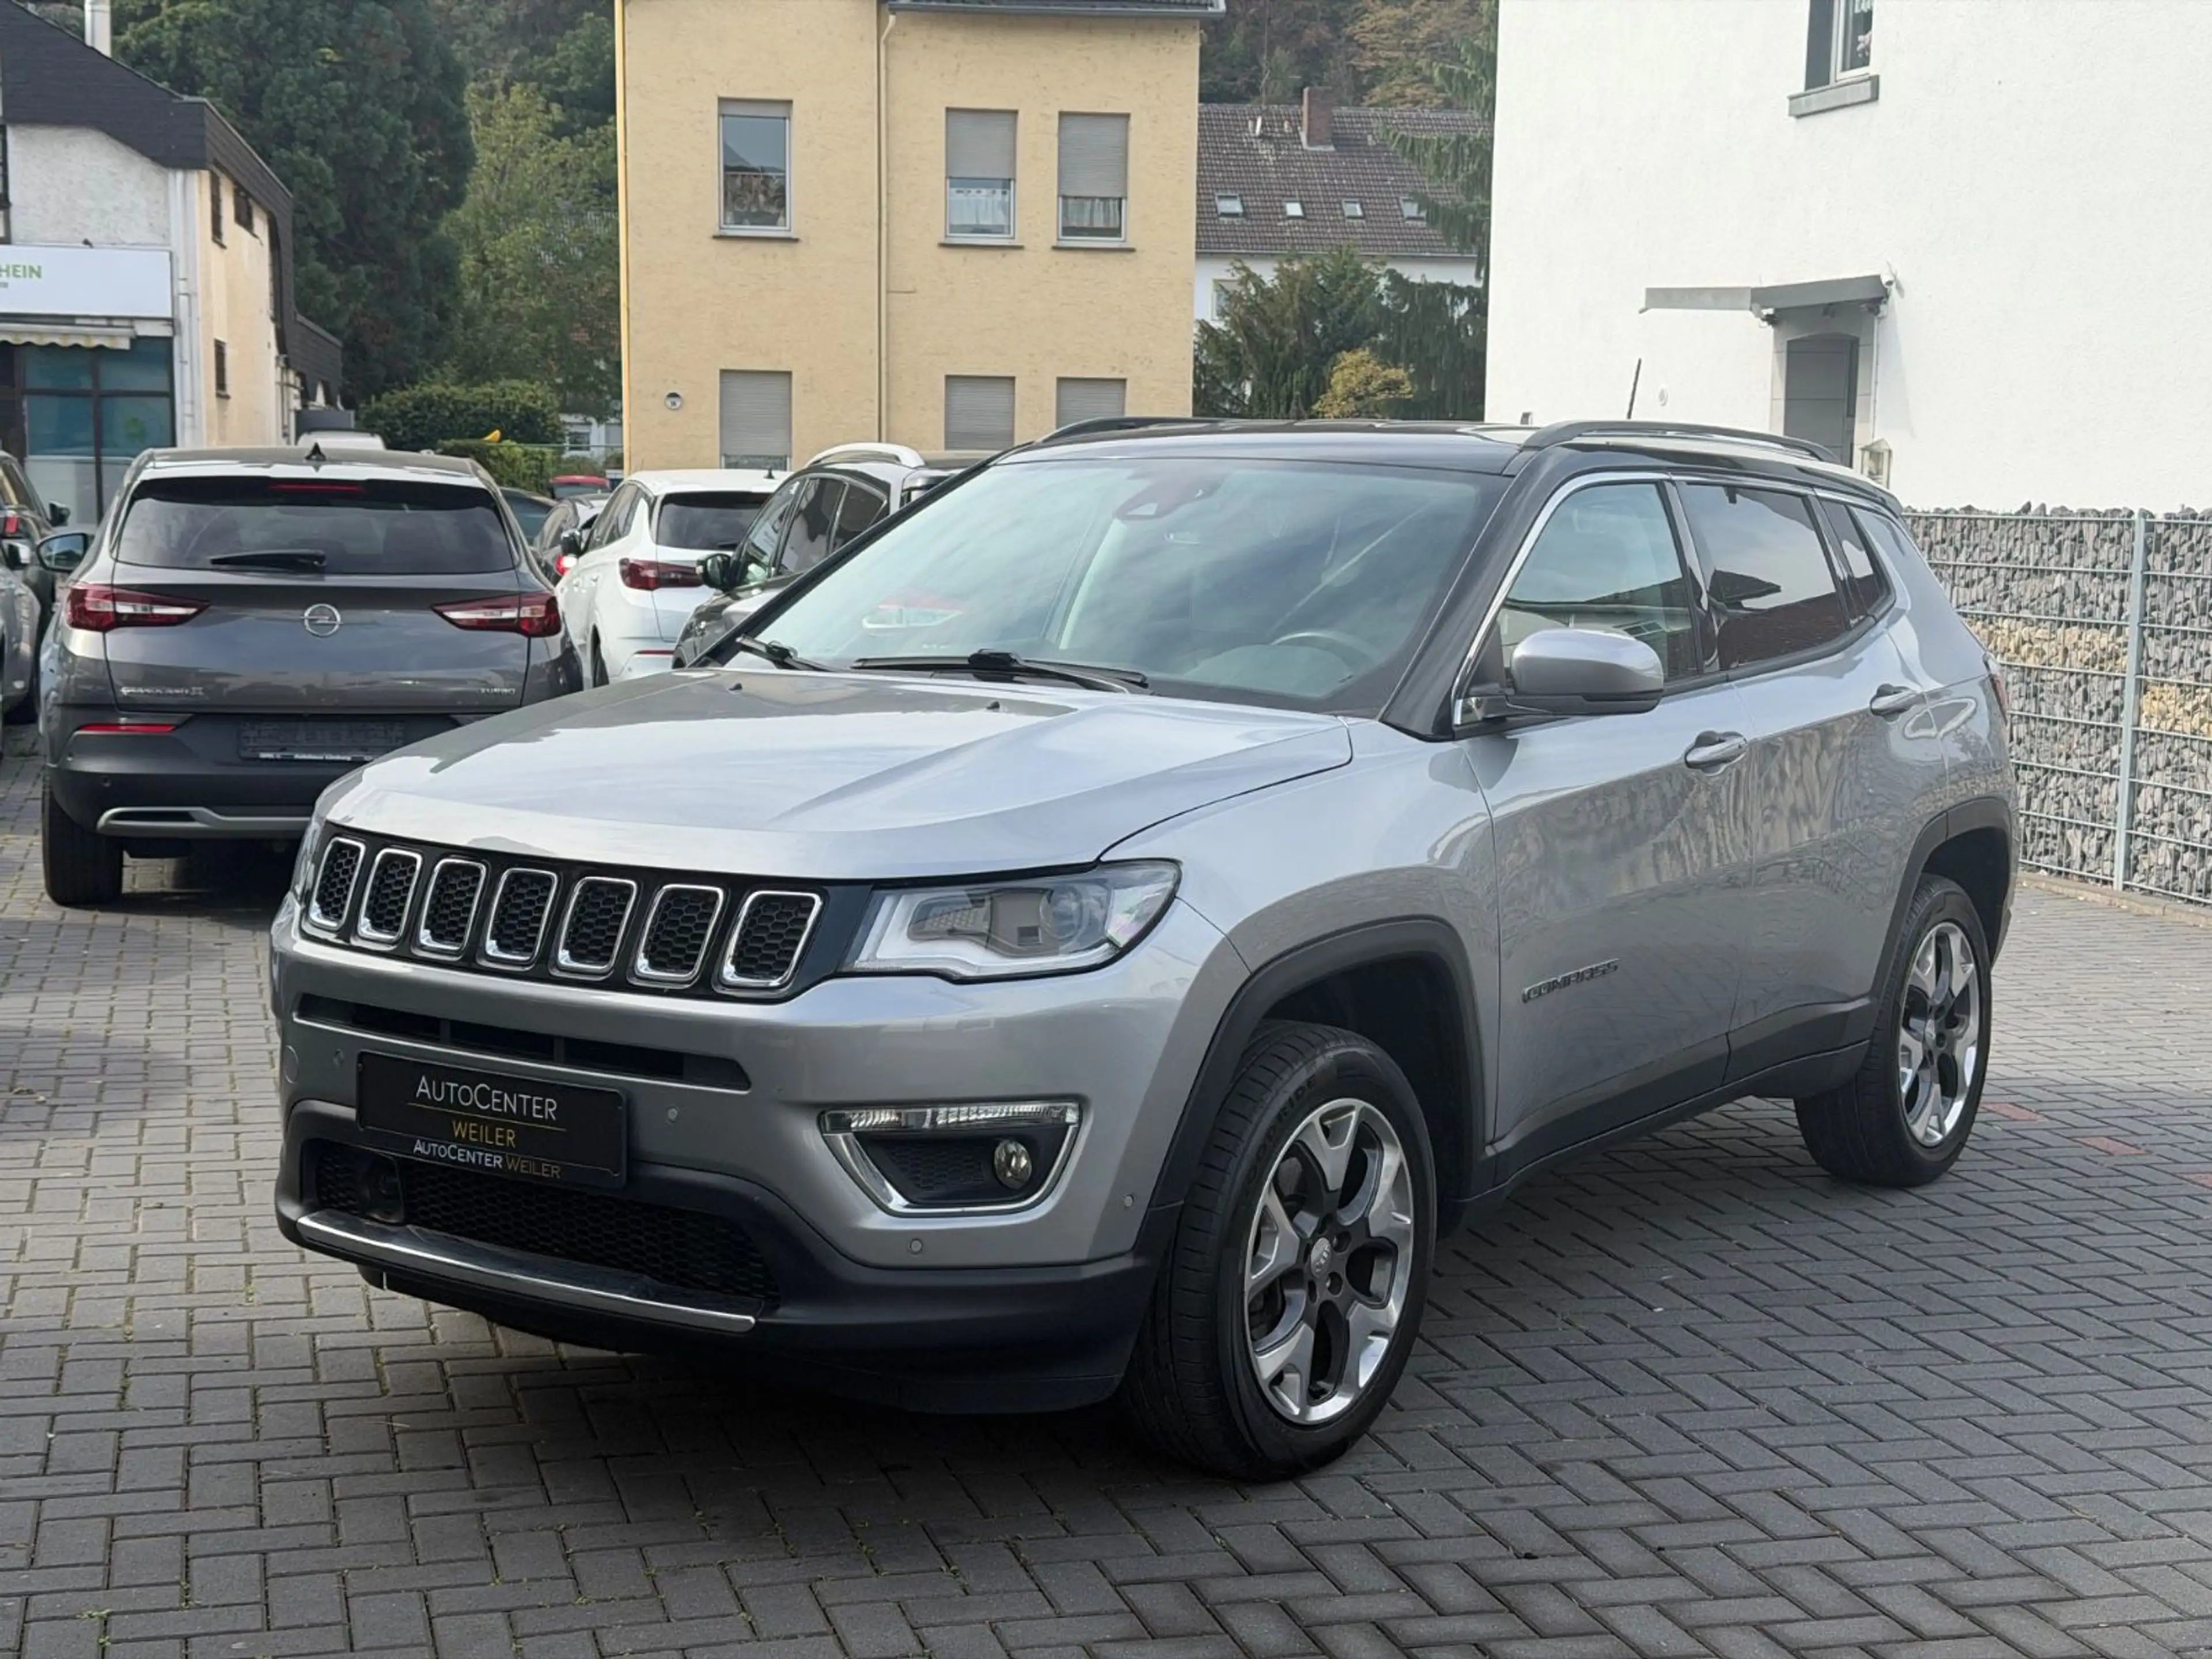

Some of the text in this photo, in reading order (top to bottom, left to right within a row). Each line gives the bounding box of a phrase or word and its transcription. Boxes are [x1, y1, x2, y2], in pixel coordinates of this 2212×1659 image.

[1521, 957, 1620, 1003] COMPASS
[453, 1120, 516, 1147] WEILER
[506, 1155, 560, 1179] WEILER
